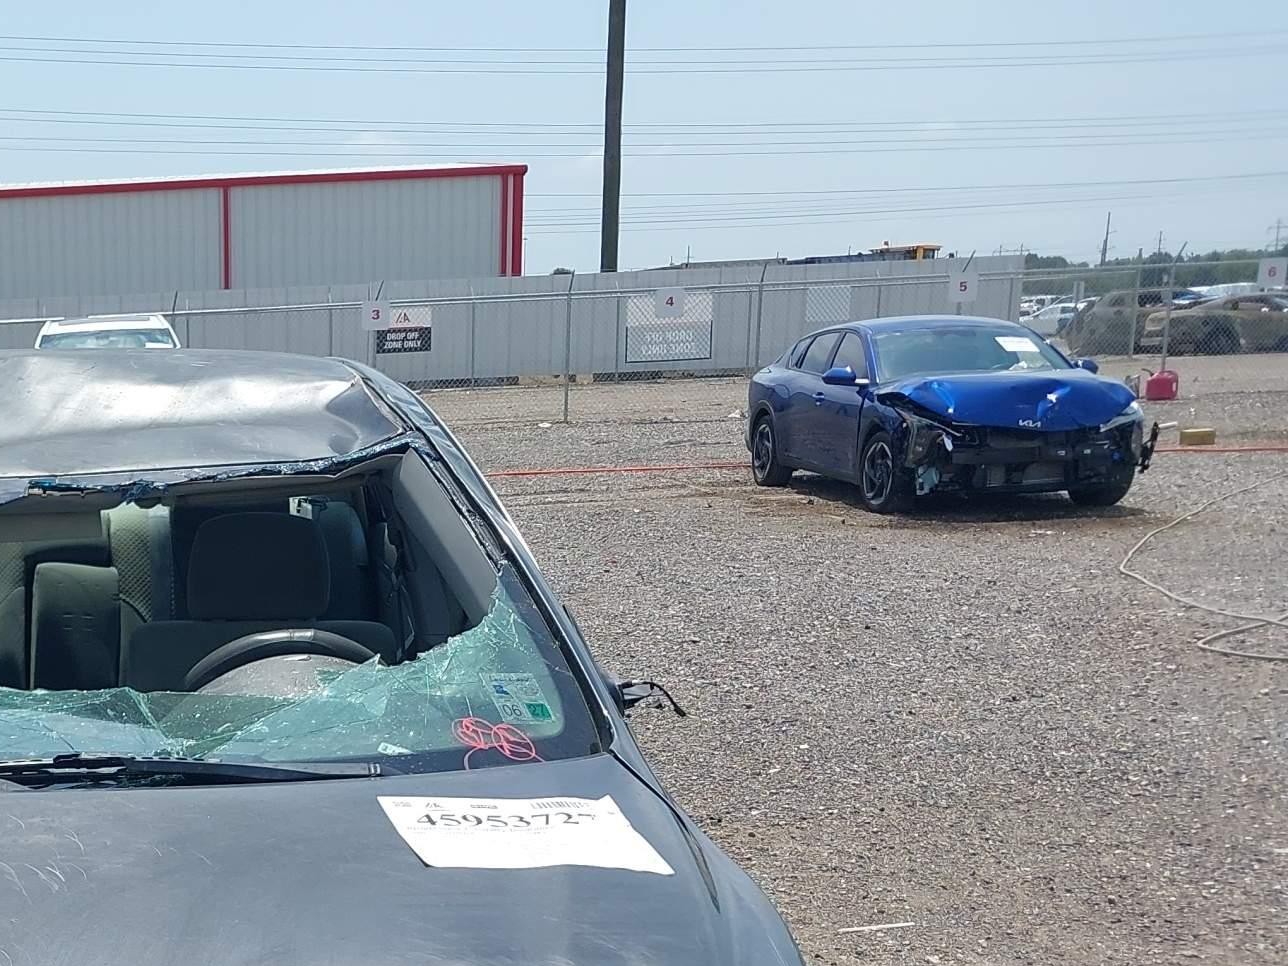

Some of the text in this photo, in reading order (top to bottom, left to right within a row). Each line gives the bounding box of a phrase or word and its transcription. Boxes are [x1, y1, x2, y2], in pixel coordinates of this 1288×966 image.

[1268, 266, 1277, 278] 6
[959, 281, 968, 292] 5
[665, 296, 674, 307] 4
[371, 309, 380, 320] 3
[386, 331, 420, 341] DROP OFF
[383, 339, 422, 349] ZONE ONLY
[501, 703, 522, 717] 06
